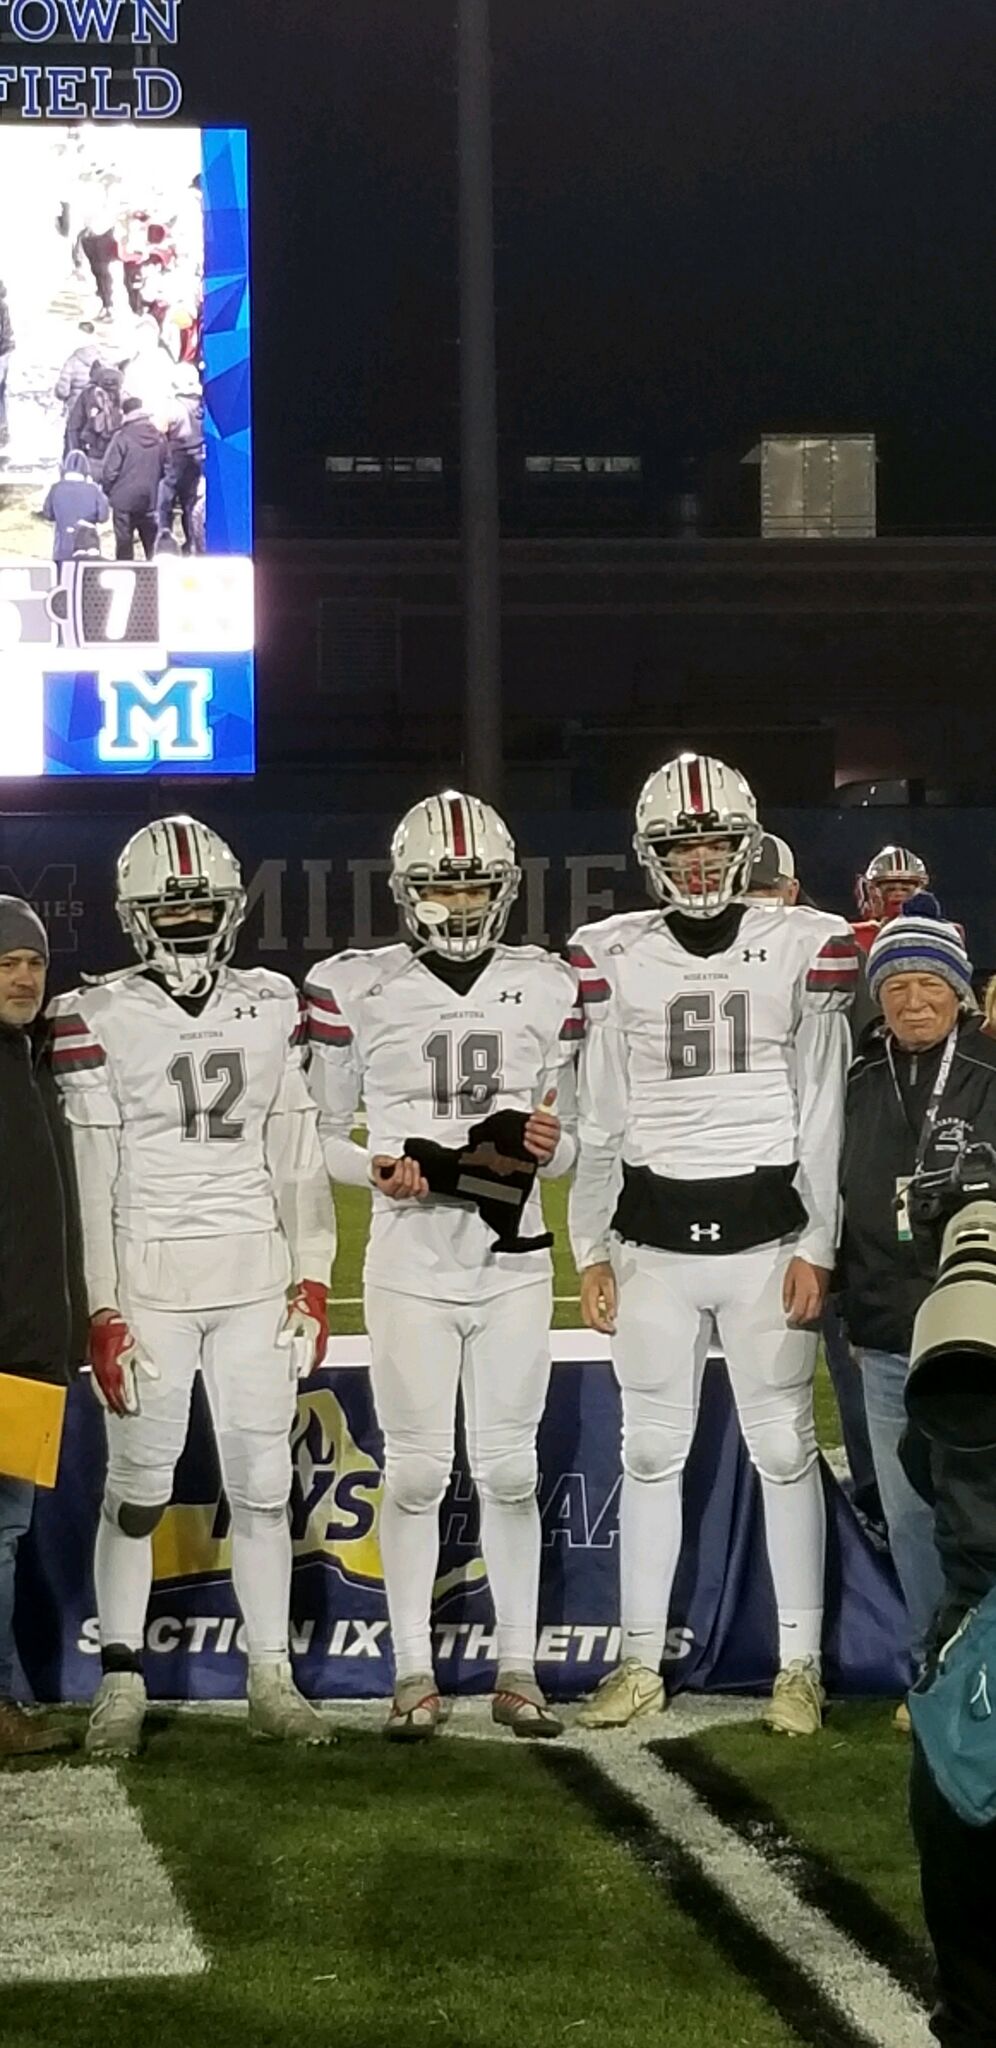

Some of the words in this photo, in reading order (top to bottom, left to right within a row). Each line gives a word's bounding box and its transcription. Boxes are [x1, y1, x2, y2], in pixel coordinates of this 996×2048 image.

[0, 0, 182, 43] OWN
[99, 568, 137, 641] 7
[99, 667, 214, 761] M
[421, 1029, 505, 1119] 18
[664, 990, 750, 1079] 61
[165, 1047, 248, 1142] 12
[77, 1616, 316, 1655] SCTIN
[327, 1619, 389, 1658] IX
